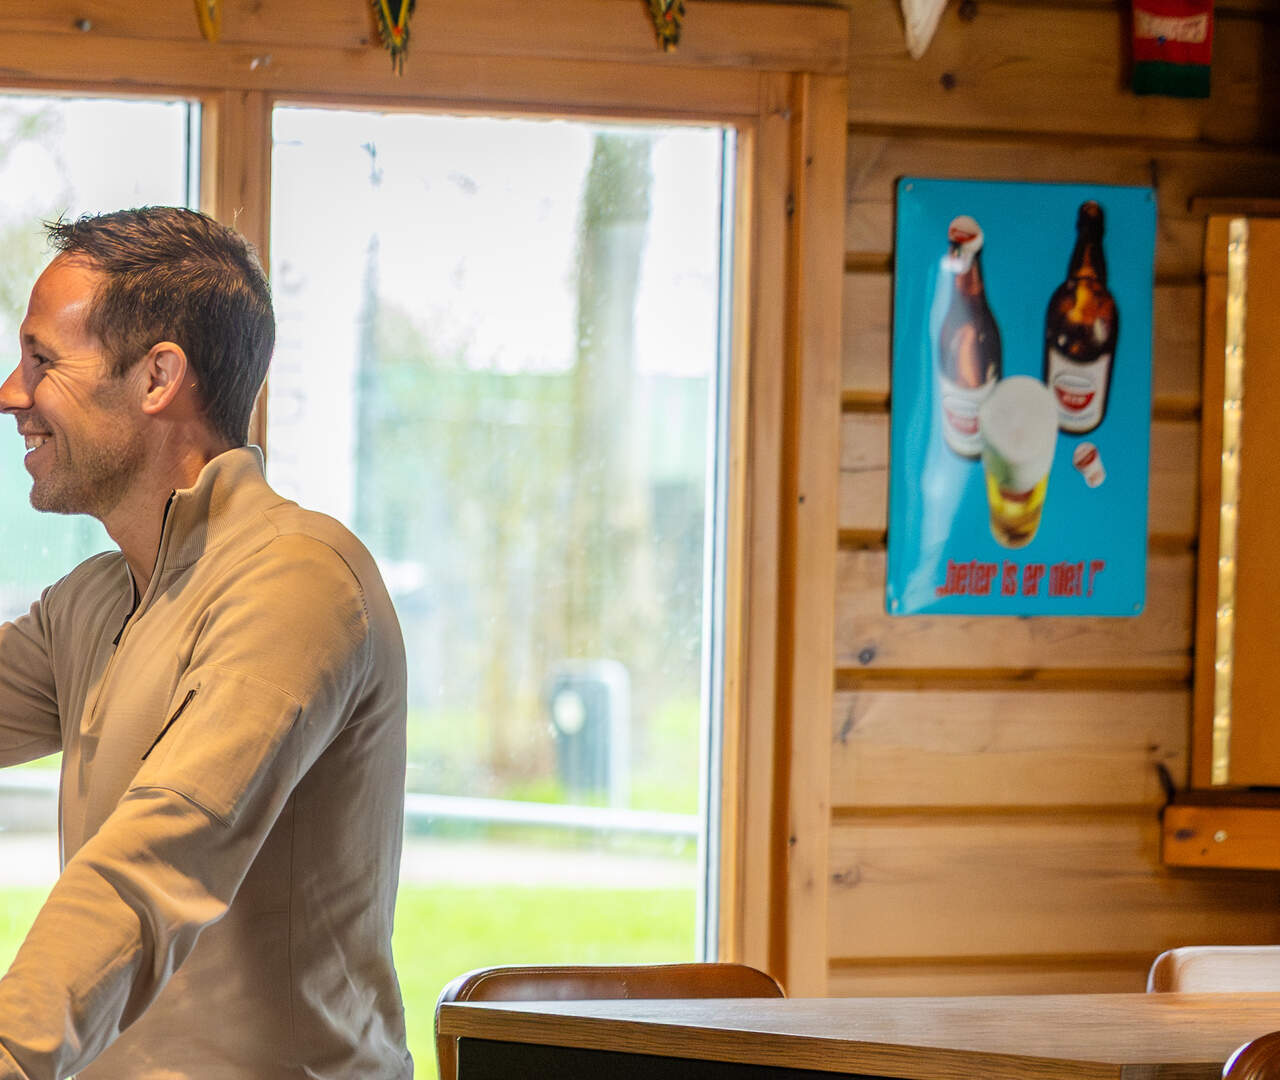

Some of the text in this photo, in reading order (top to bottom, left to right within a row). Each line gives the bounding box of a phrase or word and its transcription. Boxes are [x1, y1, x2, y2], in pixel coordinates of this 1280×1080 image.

[1001, 559, 1019, 596] is
[1022, 563, 1046, 596] er
[1048, 560, 1085, 596] niet
